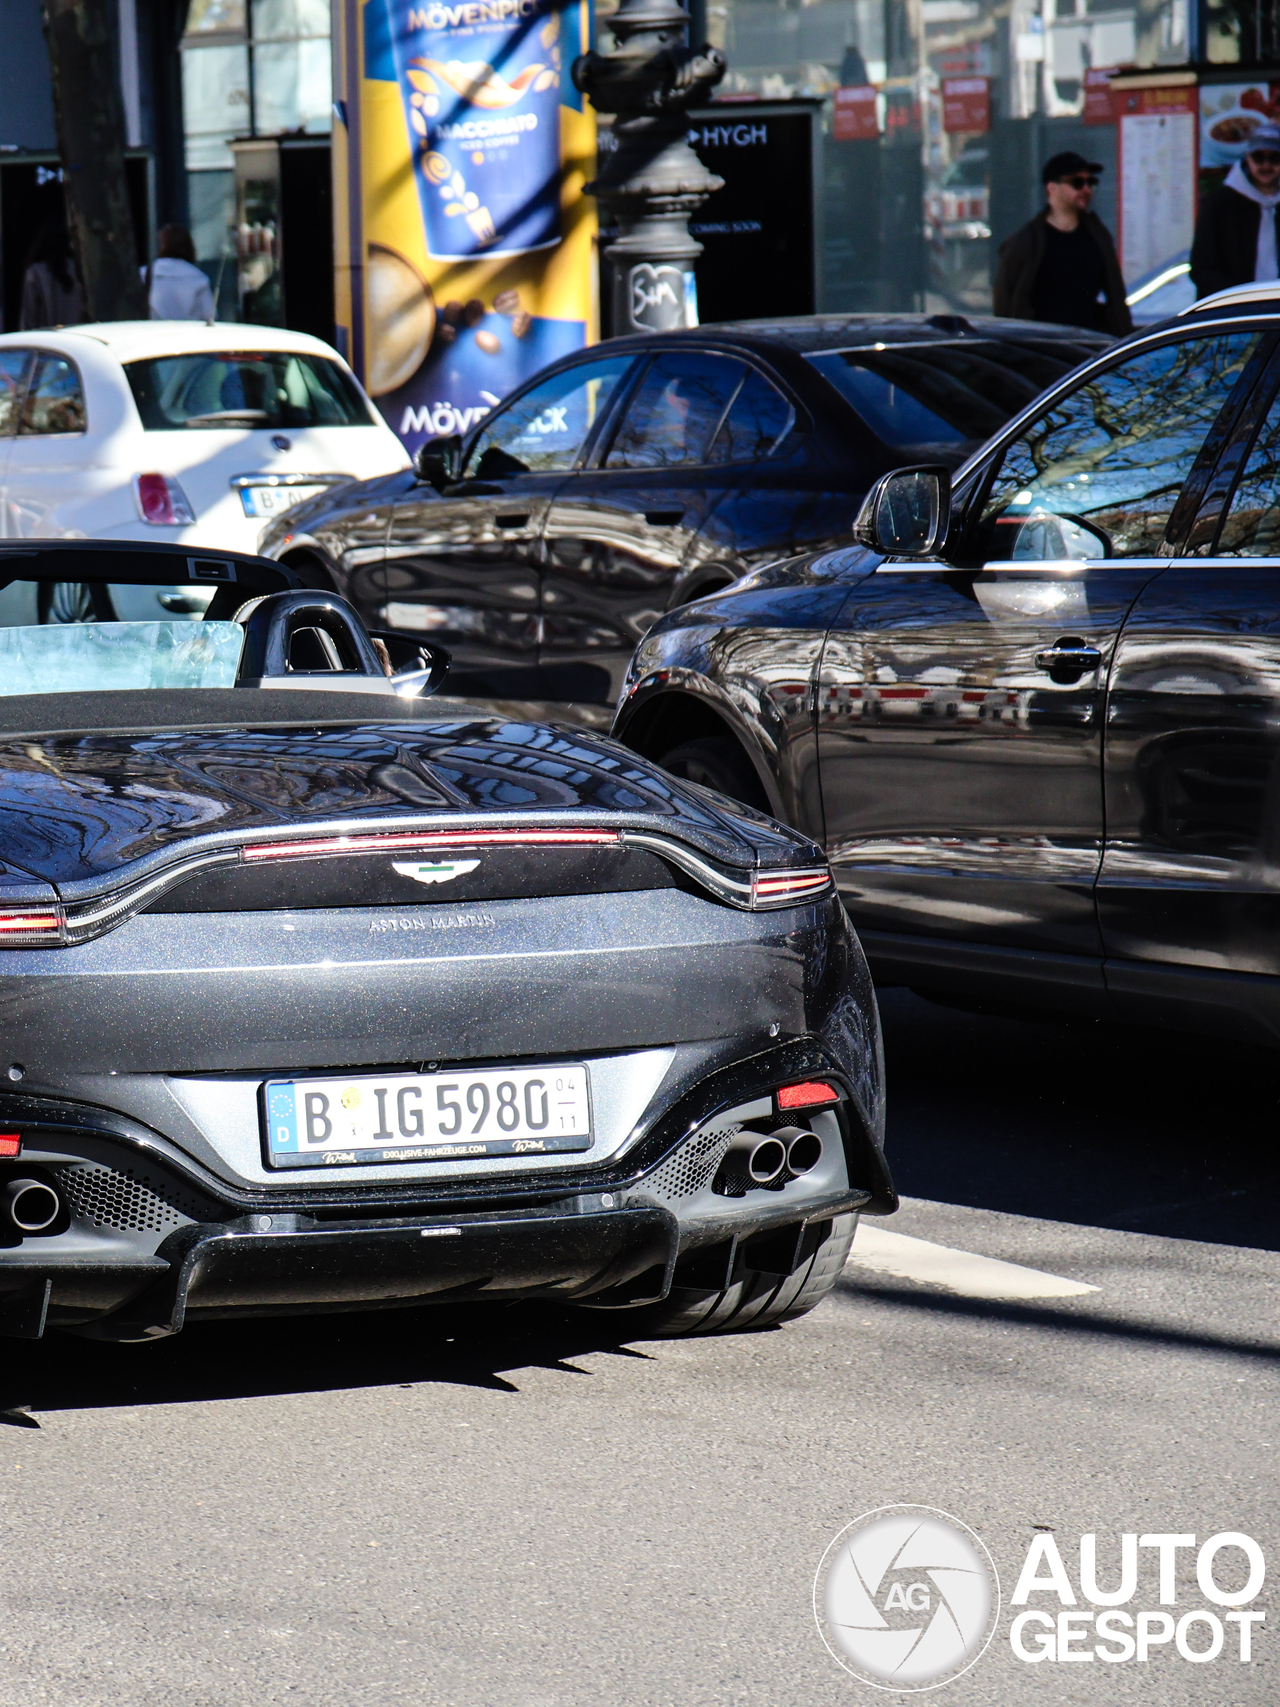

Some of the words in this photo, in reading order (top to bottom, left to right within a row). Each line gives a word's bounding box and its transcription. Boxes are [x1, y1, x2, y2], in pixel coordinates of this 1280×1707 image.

[435, 112, 538, 139] MACCHIATO
[703, 124, 767, 146] HYGH
[370, 917, 425, 932] ASTON
[430, 913, 496, 930] MARTIN
[305, 1092, 333, 1144] B
[373, 1086, 426, 1140] IG
[436, 1078, 550, 1136] 5980
[277, 1127, 290, 1143] D
[382, 1144, 487, 1160] EXKLUSIVE-FAHRZEUGE.COM
